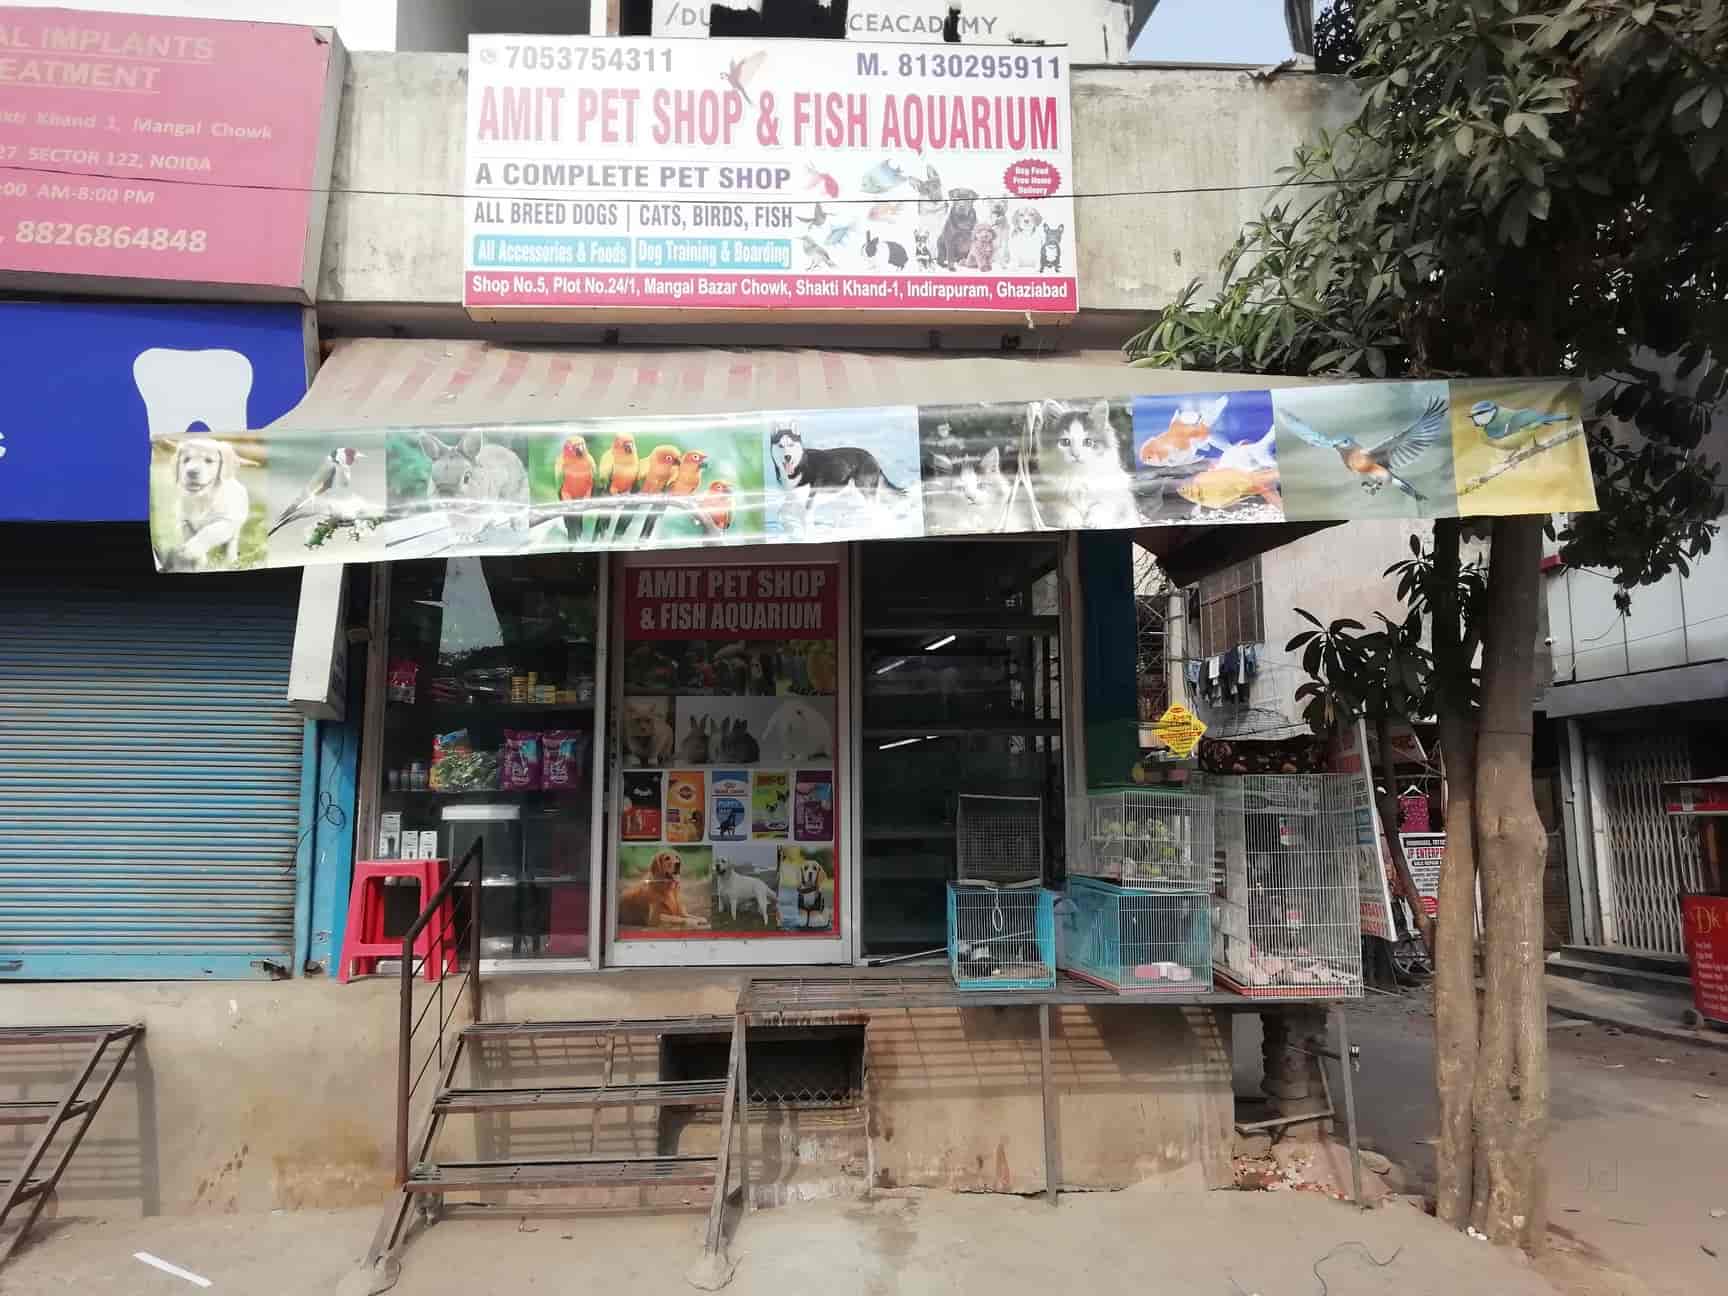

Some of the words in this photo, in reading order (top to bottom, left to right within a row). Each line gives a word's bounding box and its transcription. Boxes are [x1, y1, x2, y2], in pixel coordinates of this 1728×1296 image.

[849, 14, 997, 33] CEACADMY
[42, 27, 214, 58] IMPLANTS
[505, 46, 672, 72] 7053754311
[857, 52, 888, 76] M.
[899, 54, 1060, 79] 8130295911
[134, 117, 202, 137] Mangal
[211, 123, 272, 139] Chowk
[477, 86, 565, 141] AMIT
[577, 88, 641, 143] PET
[652, 89, 744, 145] SHOP
[756, 90, 780, 146] &
[793, 92, 868, 148] FISH
[881, 94, 1058, 156] AQUARIUM
[28, 148, 99, 165] SECTOR
[150, 155, 211, 171] NOIDA
[475, 163, 493, 184] A
[503, 163, 649, 187] COMPLETE
[659, 166, 709, 188] PET
[719, 167, 791, 189] SHOP
[123, 188, 155, 204] PM
[474, 201, 504, 224] ALL
[510, 202, 566, 225] BREED
[572, 204, 618, 226] DOGS
[639, 205, 687, 230] CATS,
[693, 206, 749, 231] BIRDS,
[755, 206, 793, 228] FISH
[15, 221, 207, 252] 8826864848
[478, 240, 495, 261] All
[499, 240, 572, 263] Accessories
[576, 240, 587, 263] &
[591, 241, 626, 264] Foods
[639, 240, 662, 266] Dog
[666, 240, 717, 267] Training
[720, 241, 730, 262] &
[734, 241, 790, 267] Boarding
[473, 276, 509, 296] Shop
[514, 278, 549, 296] No.5,
[553, 277, 582, 294] Plot
[585, 278, 640, 297] No.24/1,
[644, 278, 694, 298] Mangal
[699, 279, 737, 295] Bazar
[741, 279, 792, 298] Chowk,
[796, 280, 839, 296] Shakti
[845, 280, 903, 300] Khand-1,
[907, 282, 992, 302] Indirapuram,
[997, 282, 1068, 298] Ghaziabad
[637, 570, 700, 598] AMIT
[707, 570, 752, 597] PET
[758, 570, 826, 597] SHOP
[640, 607, 655, 630] &
[660, 603, 706, 630] FISH
[711, 603, 822, 632] AQUARIUM
